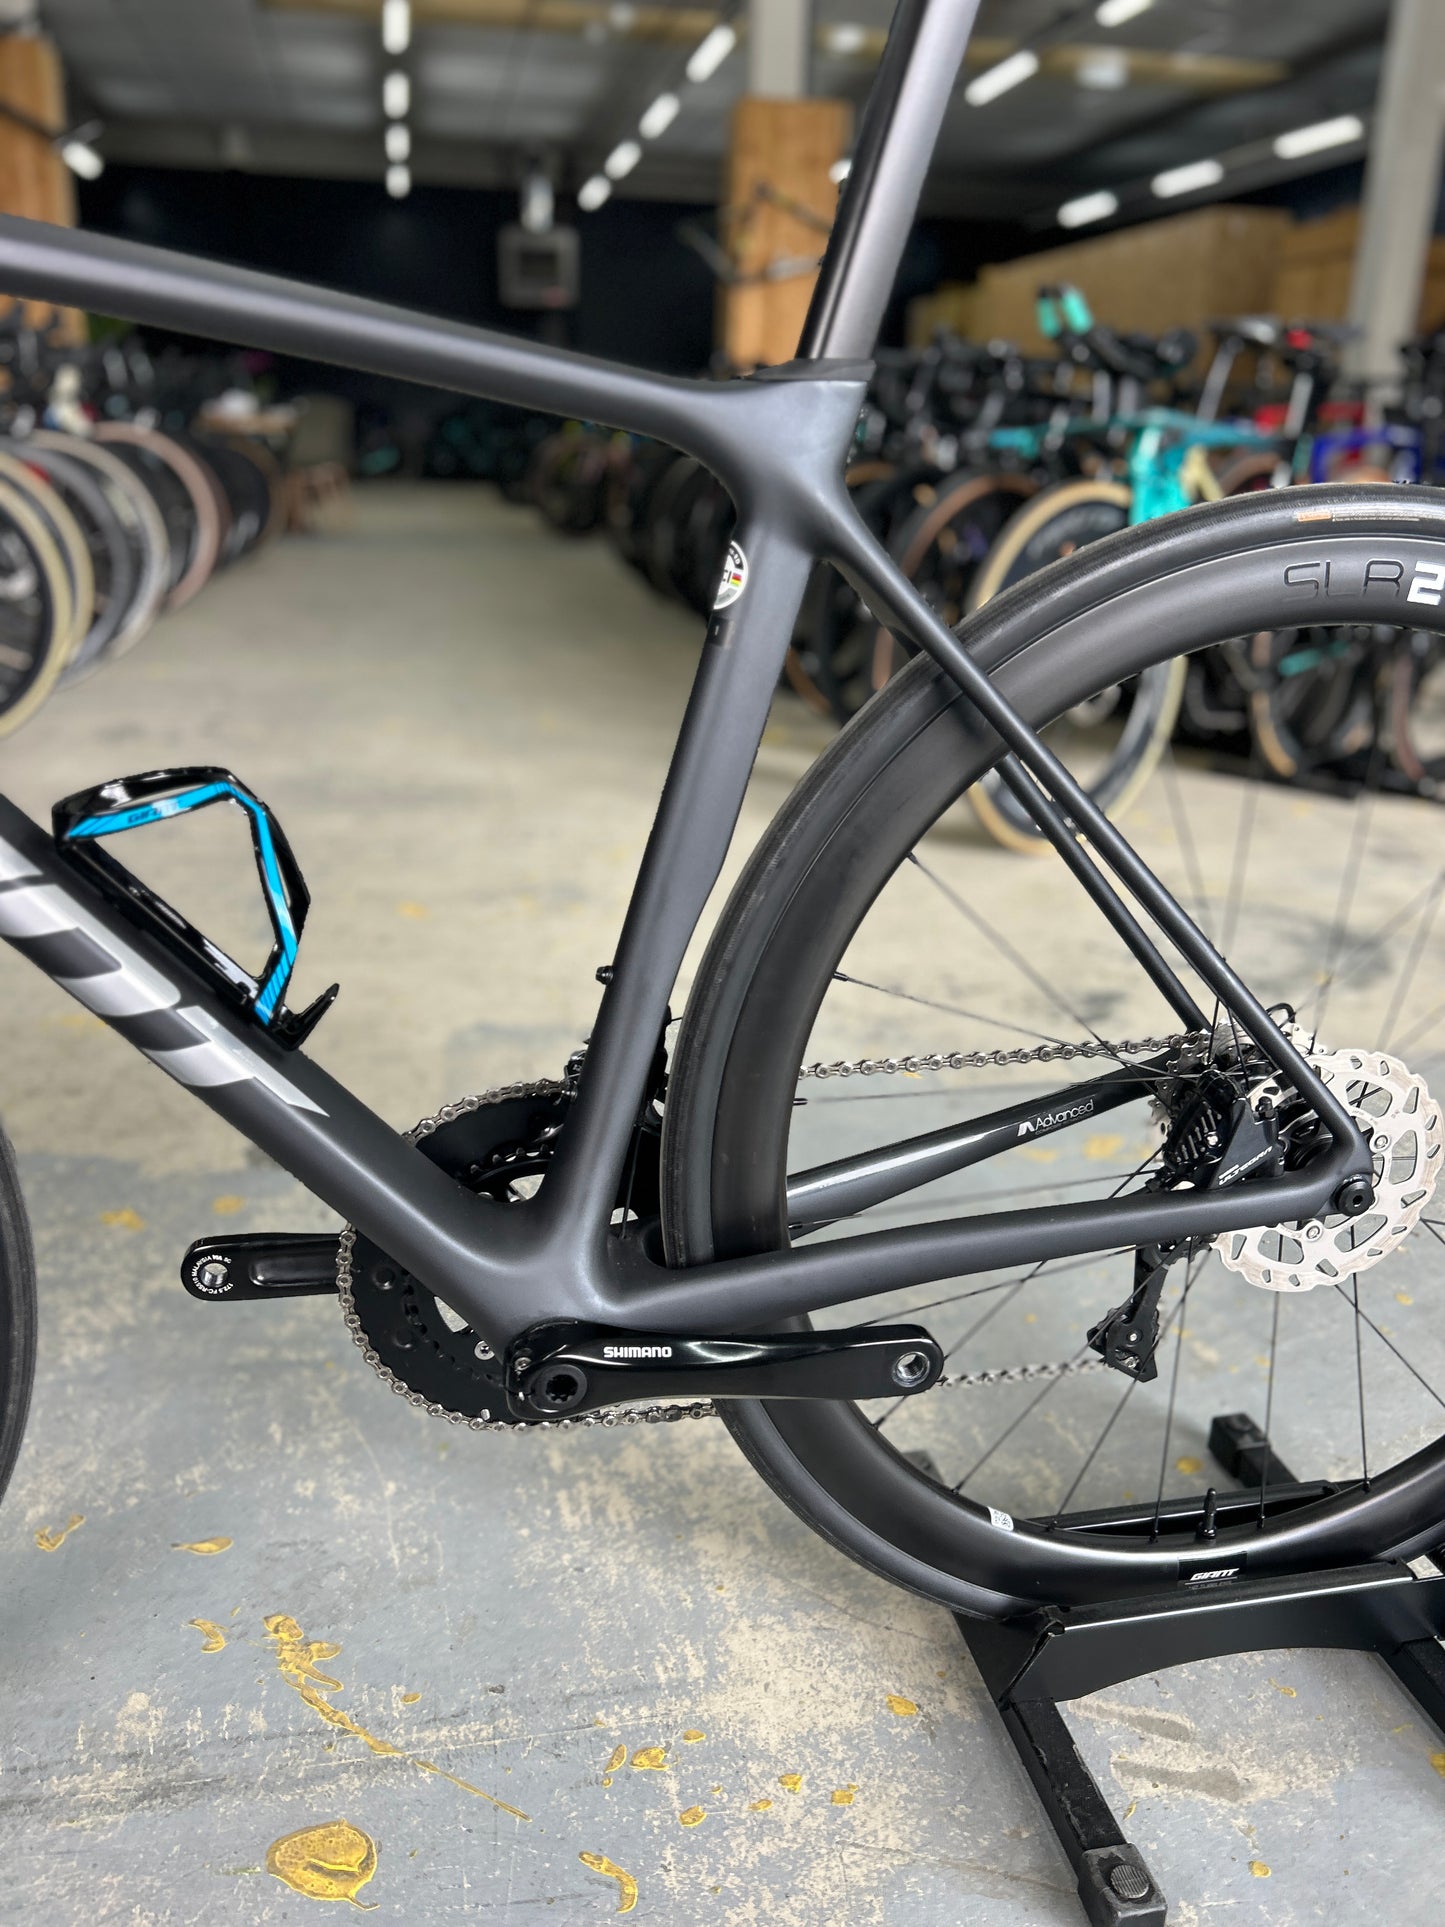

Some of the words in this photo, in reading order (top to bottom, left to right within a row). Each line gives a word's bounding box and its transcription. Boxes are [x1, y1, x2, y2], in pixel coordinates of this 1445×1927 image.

[1035, 1098, 1095, 1131] Advanced
[603, 1346, 672, 1358] SHIMANO
[1190, 1567, 1240, 1581] GIANT
